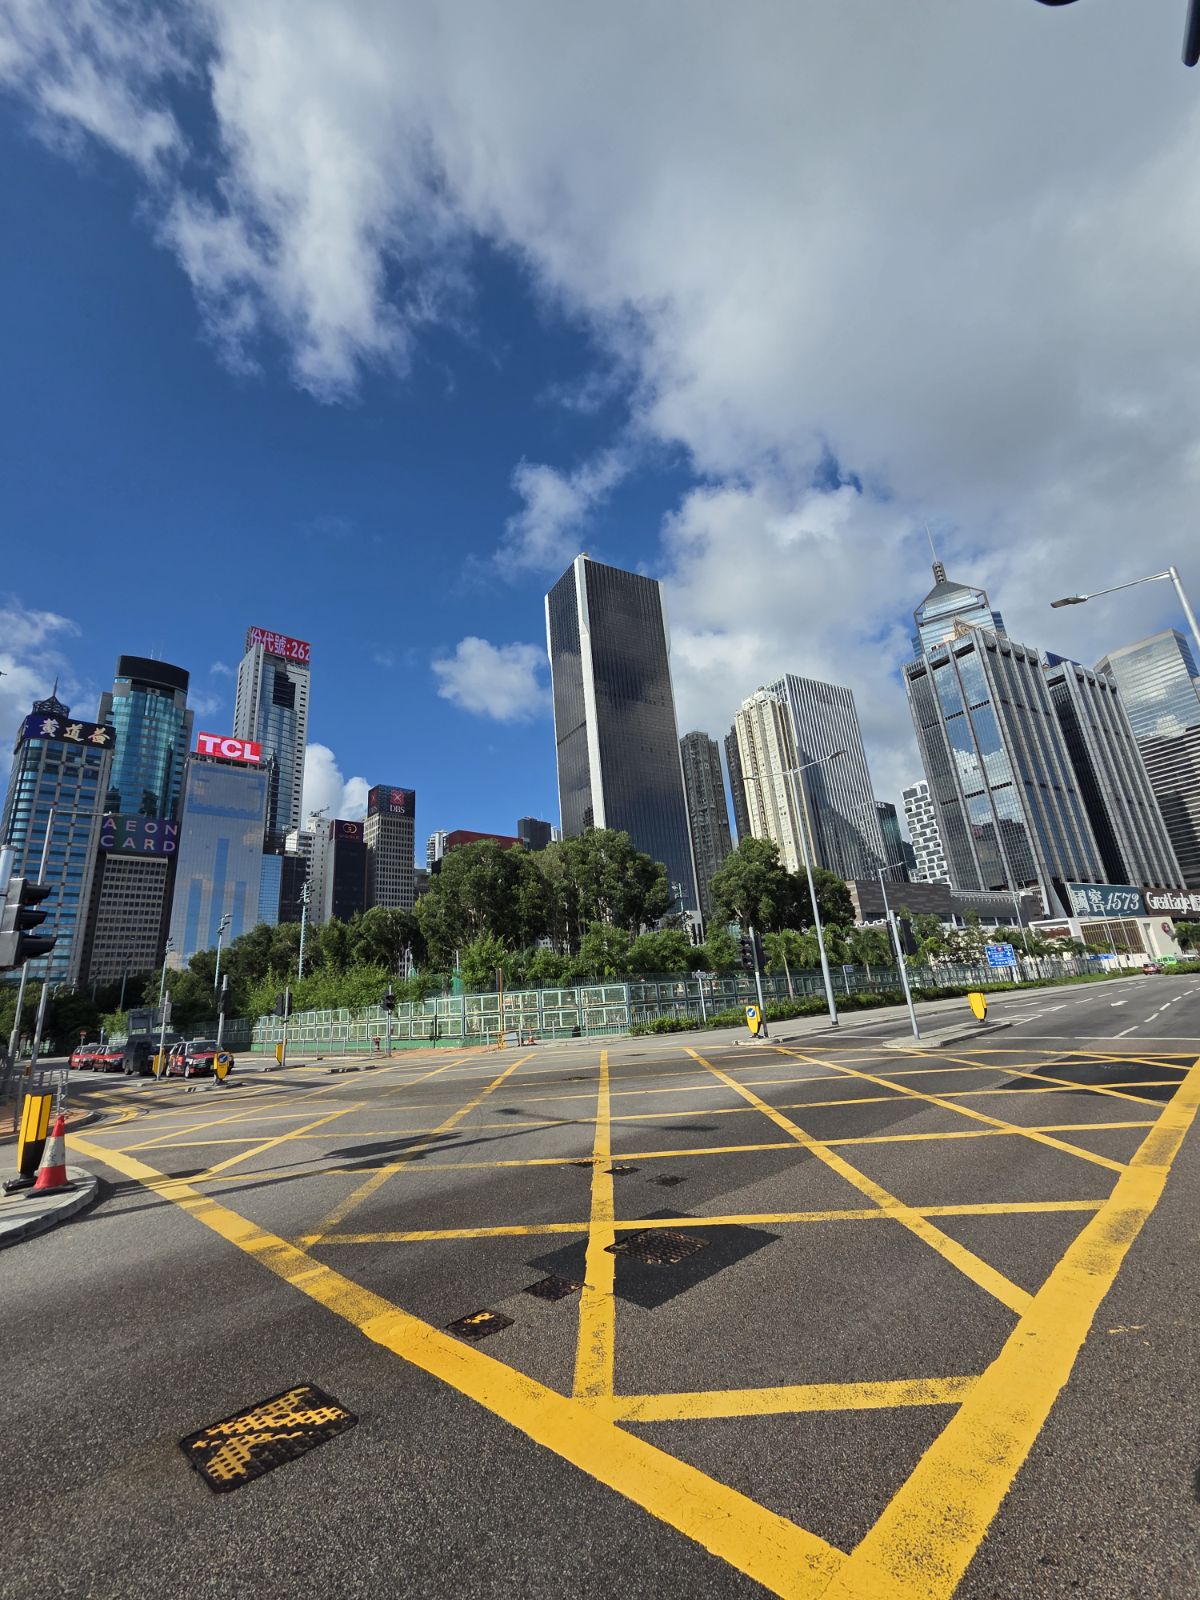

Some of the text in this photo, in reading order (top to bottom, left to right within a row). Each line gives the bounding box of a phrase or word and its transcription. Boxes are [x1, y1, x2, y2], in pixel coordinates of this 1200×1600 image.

[199, 734, 260, 761] TCL
[389, 804, 405, 814] DBS
[103, 818, 178, 836] AEON
[100, 835, 176, 852] CARD
